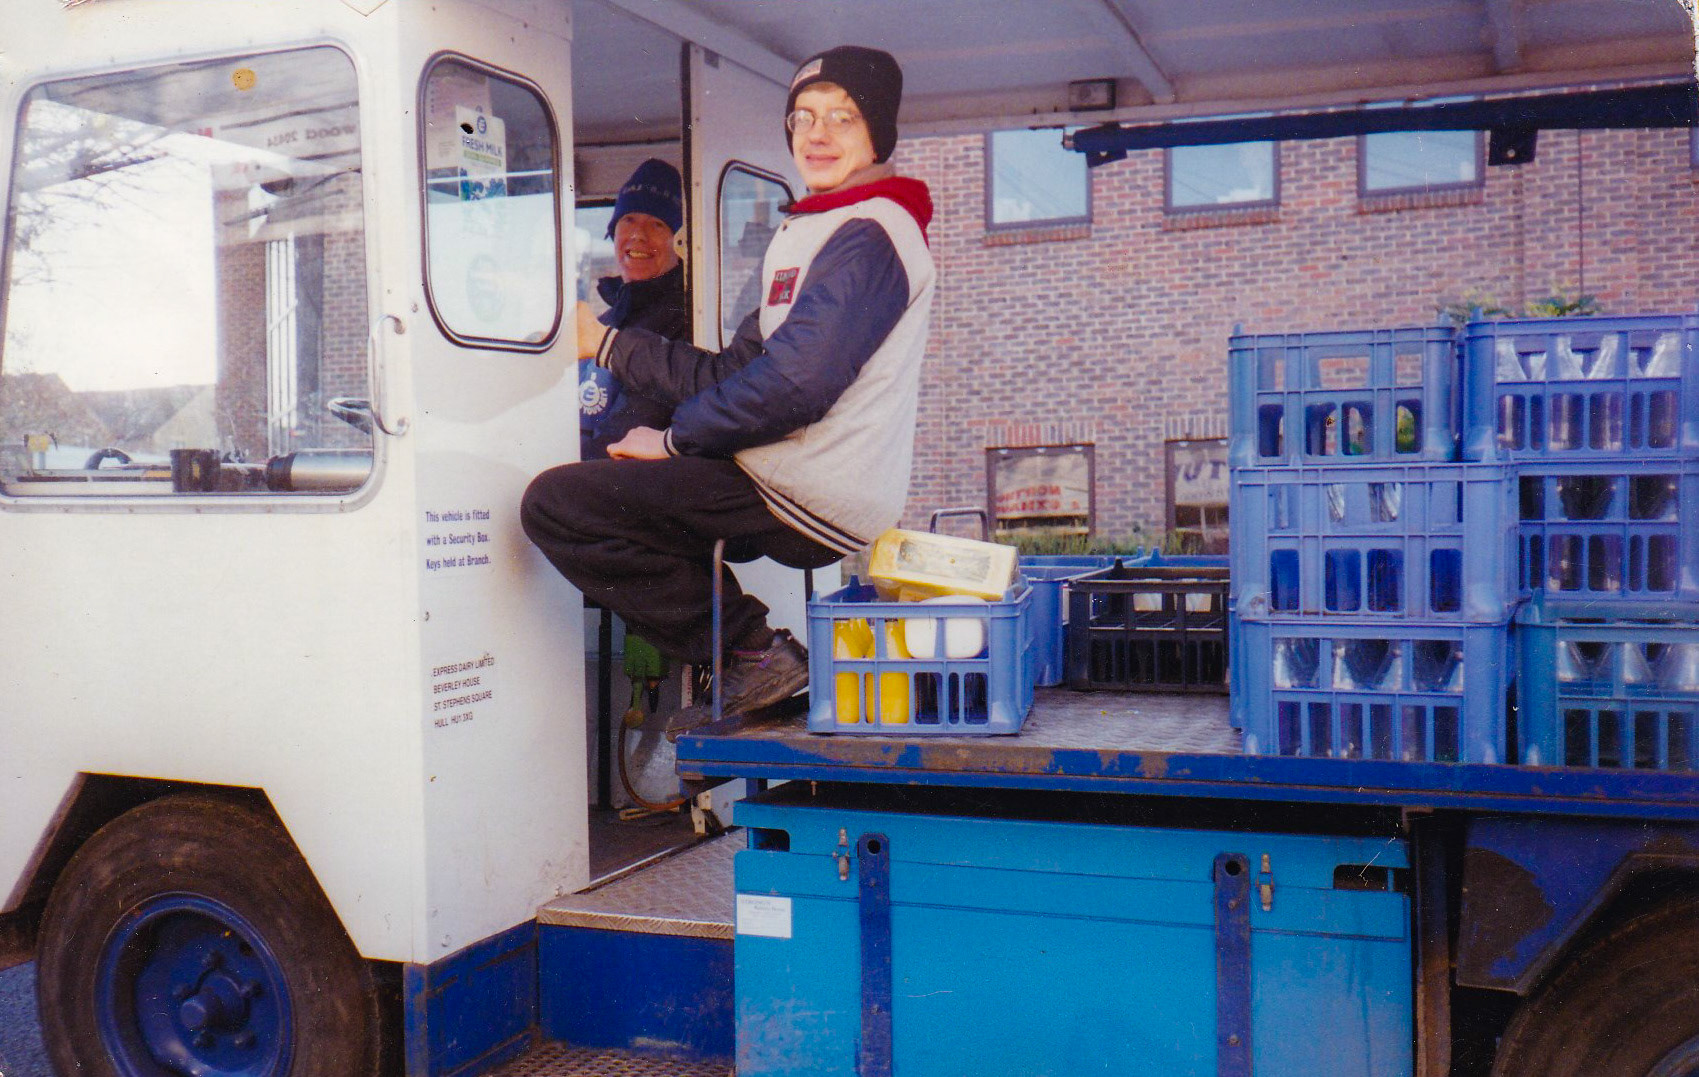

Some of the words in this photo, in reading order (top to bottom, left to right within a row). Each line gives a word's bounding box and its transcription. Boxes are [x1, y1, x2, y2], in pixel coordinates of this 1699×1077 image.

[462, 136, 484, 152] FRESH
[485, 142, 503, 158] MILK
[426, 511, 439, 522] This
[442, 510, 463, 521] vehicle
[465, 510, 471, 520] is
[472, 508, 490, 520] fitted
[427, 535, 440, 546] with
[443, 536, 447, 545] a
[449, 532, 475, 545] Security
[426, 558, 440, 571] Keys
[443, 557, 456, 567] held
[458, 557, 465, 567] at
[467, 554, 491, 566] Branch.
[433, 664, 458, 677] EXPRESS
[459, 661, 474, 672] DAIRY
[475, 656, 495, 669] LIMITED
[433, 680, 461, 694] BEVERLEY
[462, 676, 481, 688] HOUSE
[443, 695, 471, 709] STEPHENS
[472, 690, 493, 703] SQUARE
[434, 717, 449, 728] HULL
